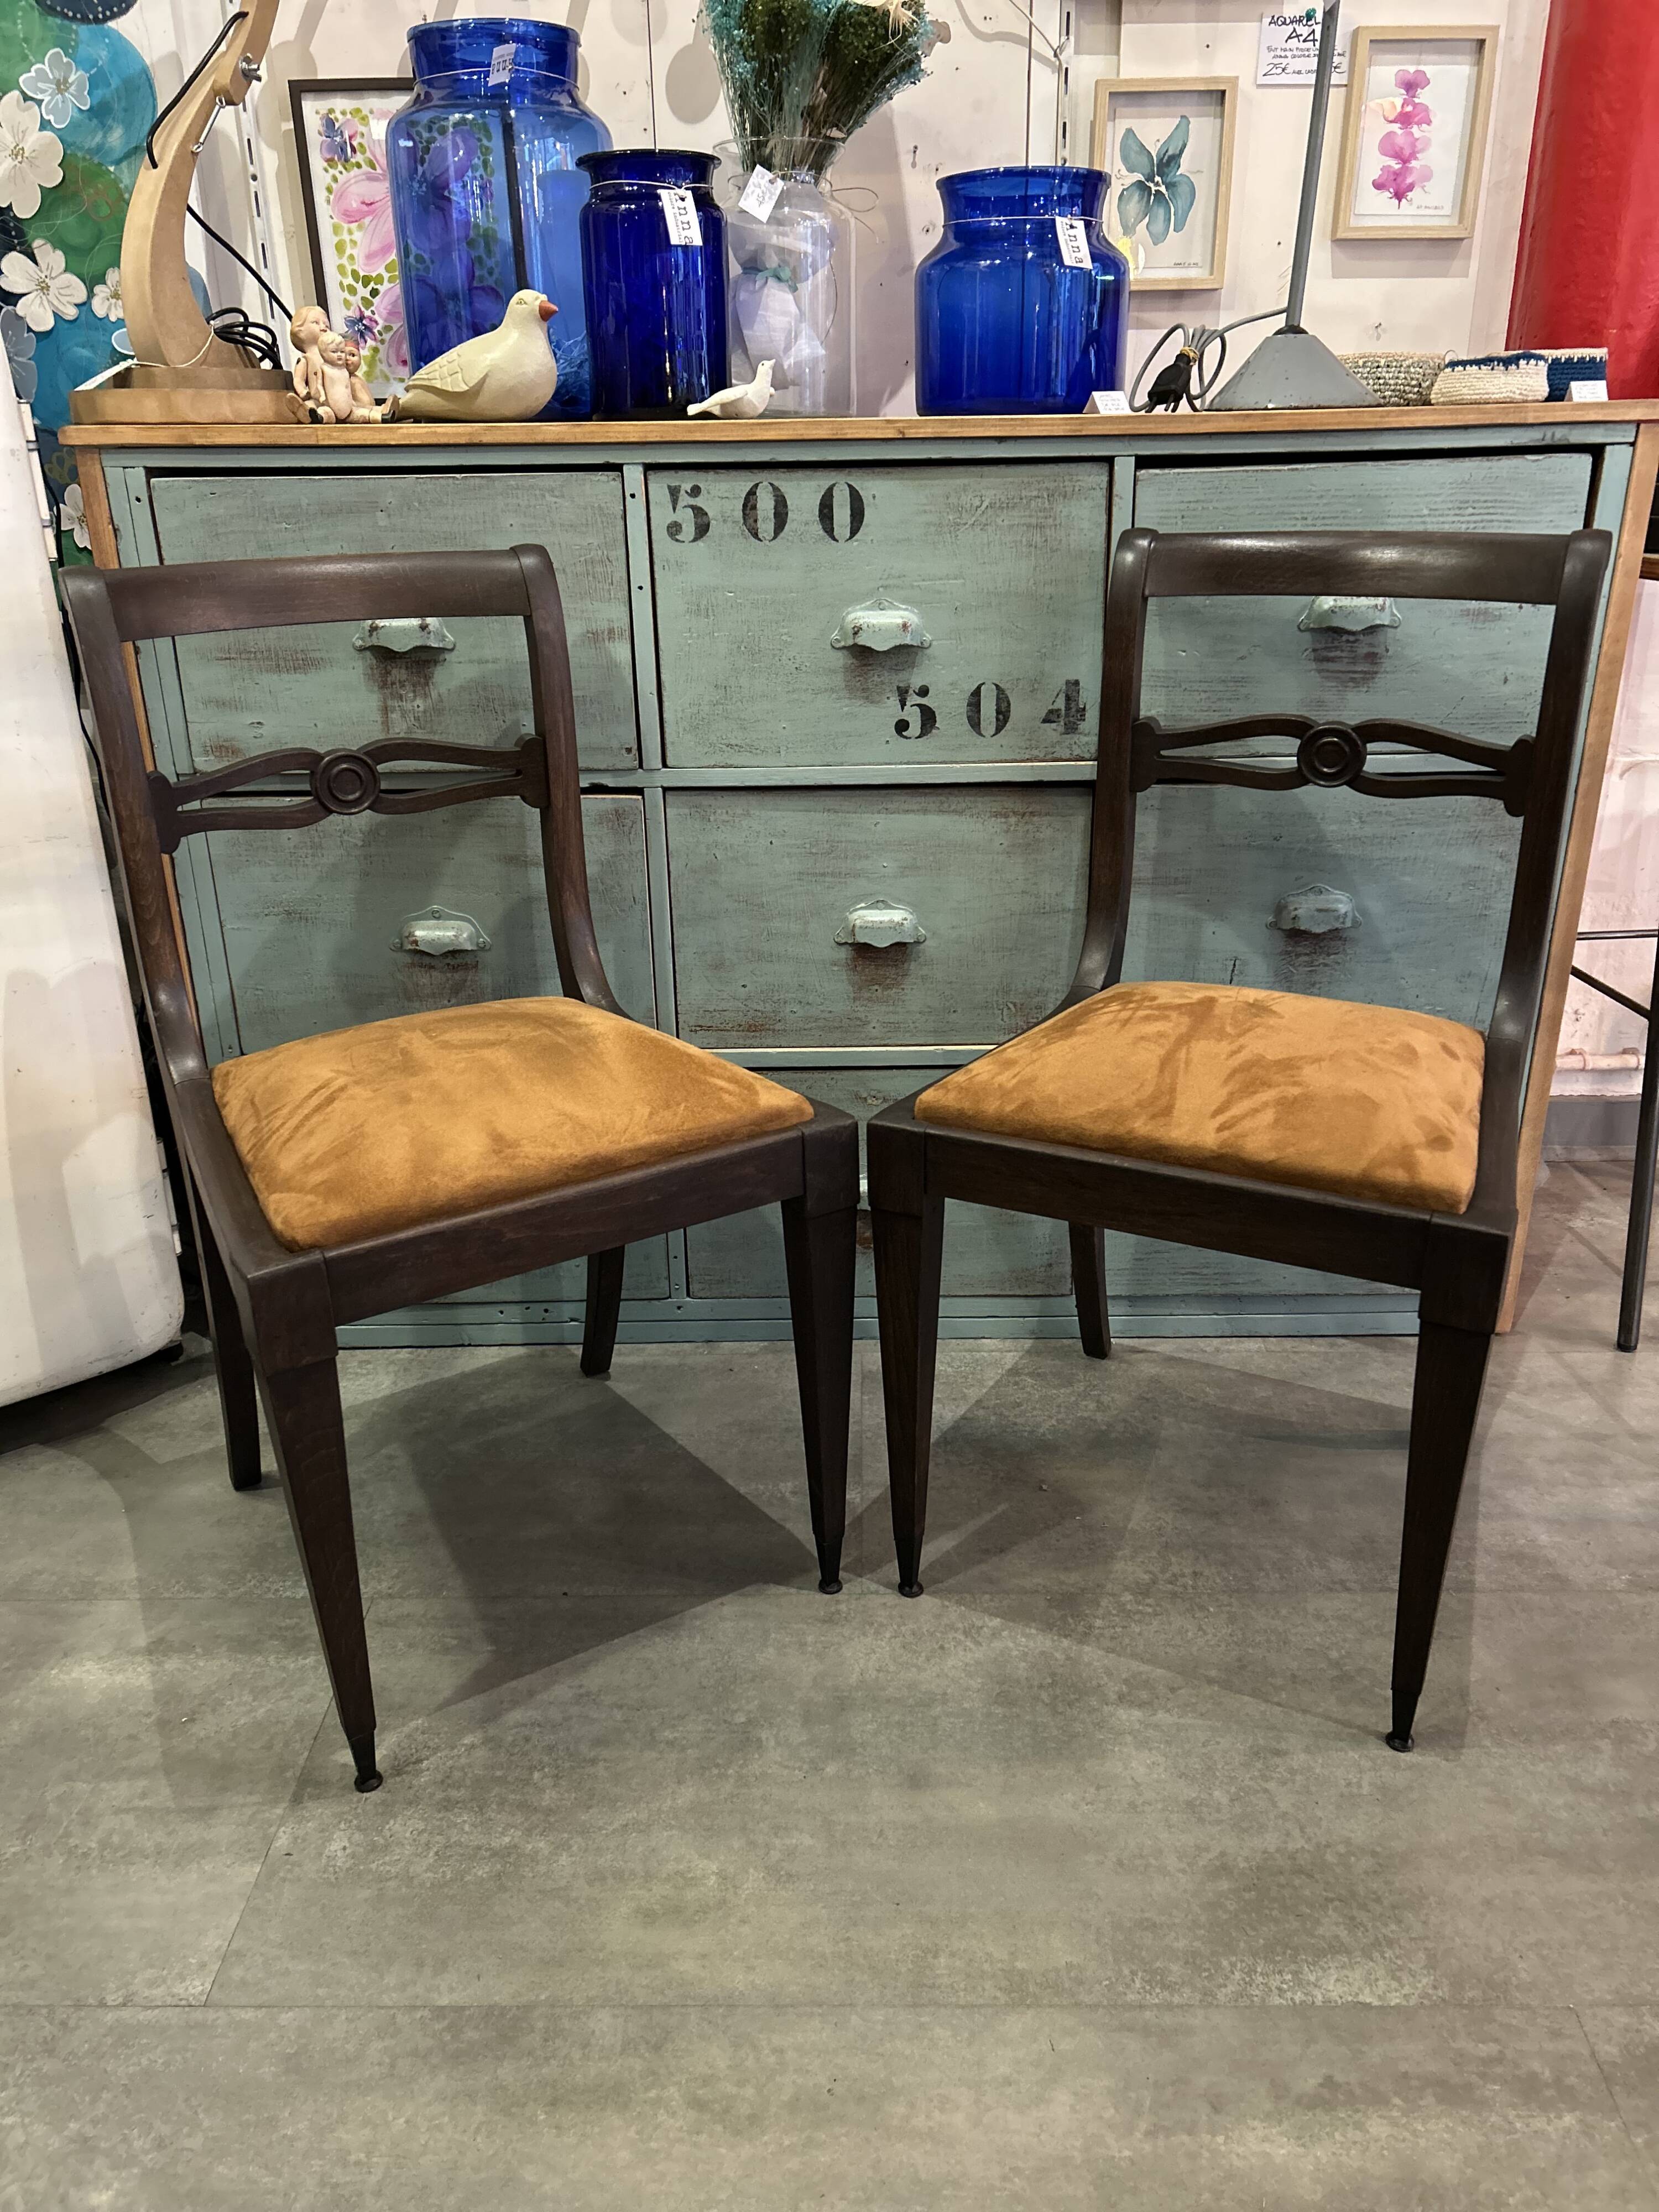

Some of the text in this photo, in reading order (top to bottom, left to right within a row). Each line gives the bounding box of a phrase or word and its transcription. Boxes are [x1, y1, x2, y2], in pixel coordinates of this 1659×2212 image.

[1285, 27, 1318, 47] A4
[1262, 62, 1290, 76] 25€
[1065, 222, 1083, 264] Anna
